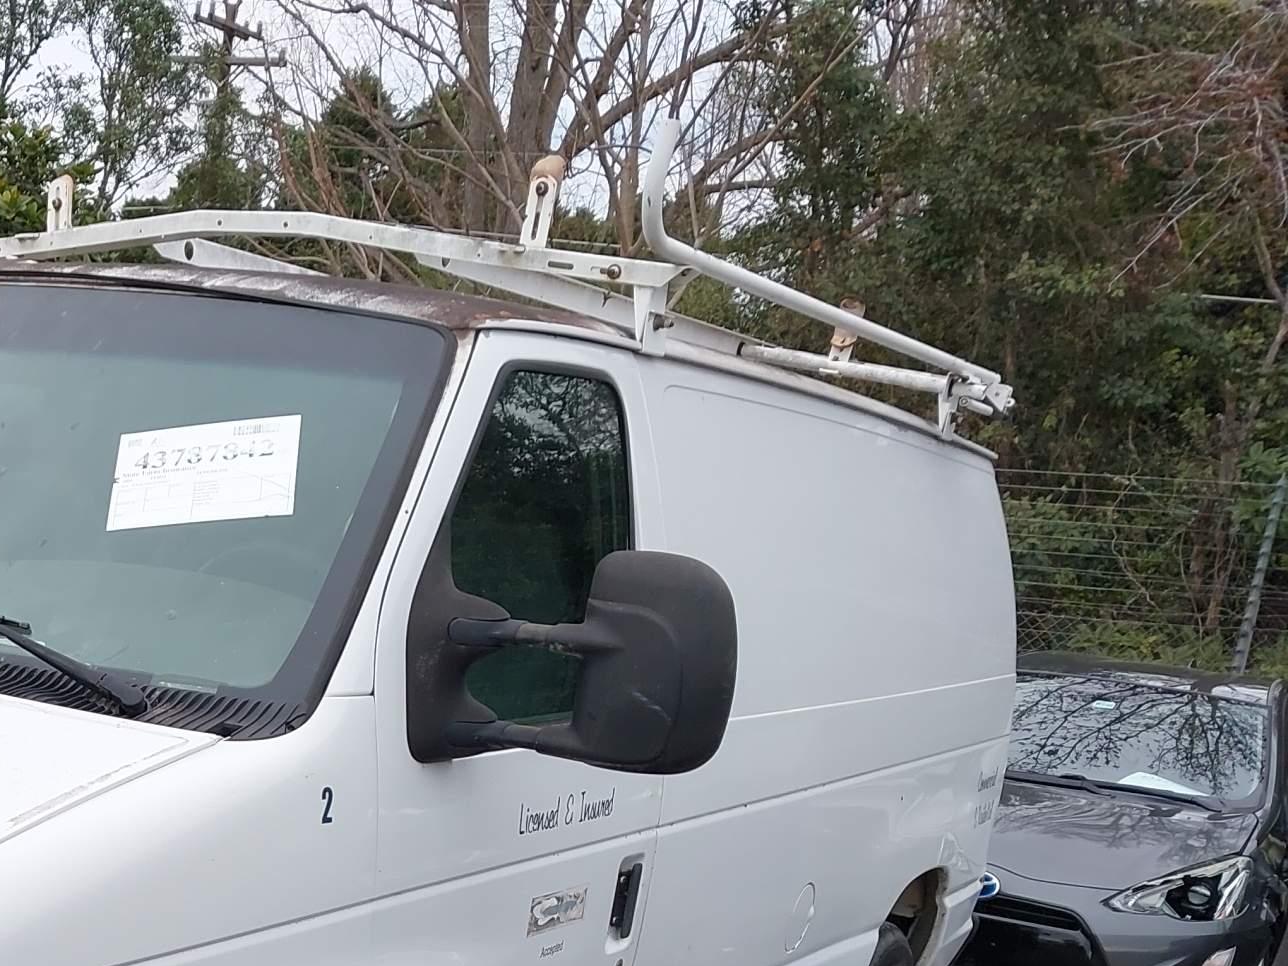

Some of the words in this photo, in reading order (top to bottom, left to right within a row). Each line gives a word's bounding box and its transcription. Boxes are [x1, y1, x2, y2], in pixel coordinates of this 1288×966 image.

[133, 439, 275, 470] 43787842
[320, 786, 334, 824] 2
[519, 795, 561, 835] Licensed
[579, 787, 616, 823] Insured
